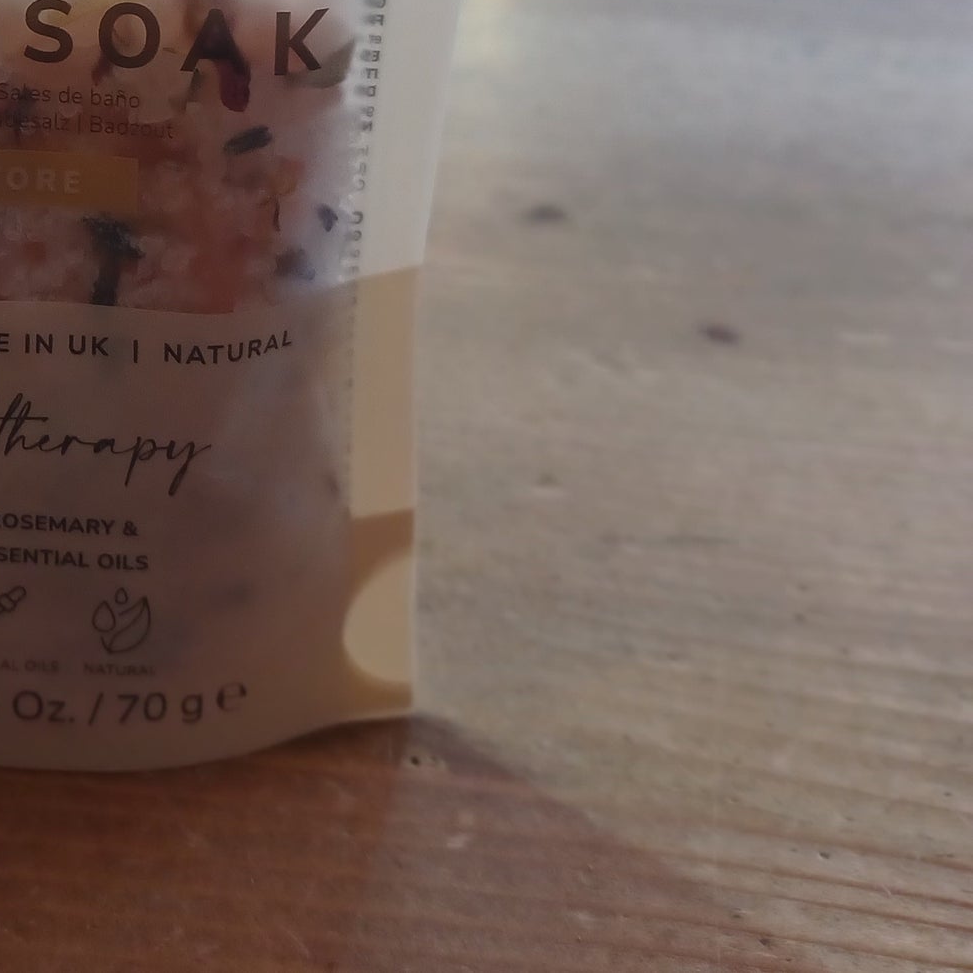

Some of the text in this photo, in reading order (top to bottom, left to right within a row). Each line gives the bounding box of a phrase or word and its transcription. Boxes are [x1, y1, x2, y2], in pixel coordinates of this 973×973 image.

[58, 86, 83, 104] de
[90, 89, 140, 108] baño
[25, 333, 53, 354] IN
[68, 334, 109, 357] UK
[163, 330, 293, 365] NATURAL
[122, 520, 139, 537] &
[97, 553, 149, 570] OILS
[24, 659, 60, 673] OILS
[82, 662, 157, 677] NATURAL
[12, 689, 76, 724] Oz.
[116, 691, 168, 724] 70
[180, 693, 203, 724] g
